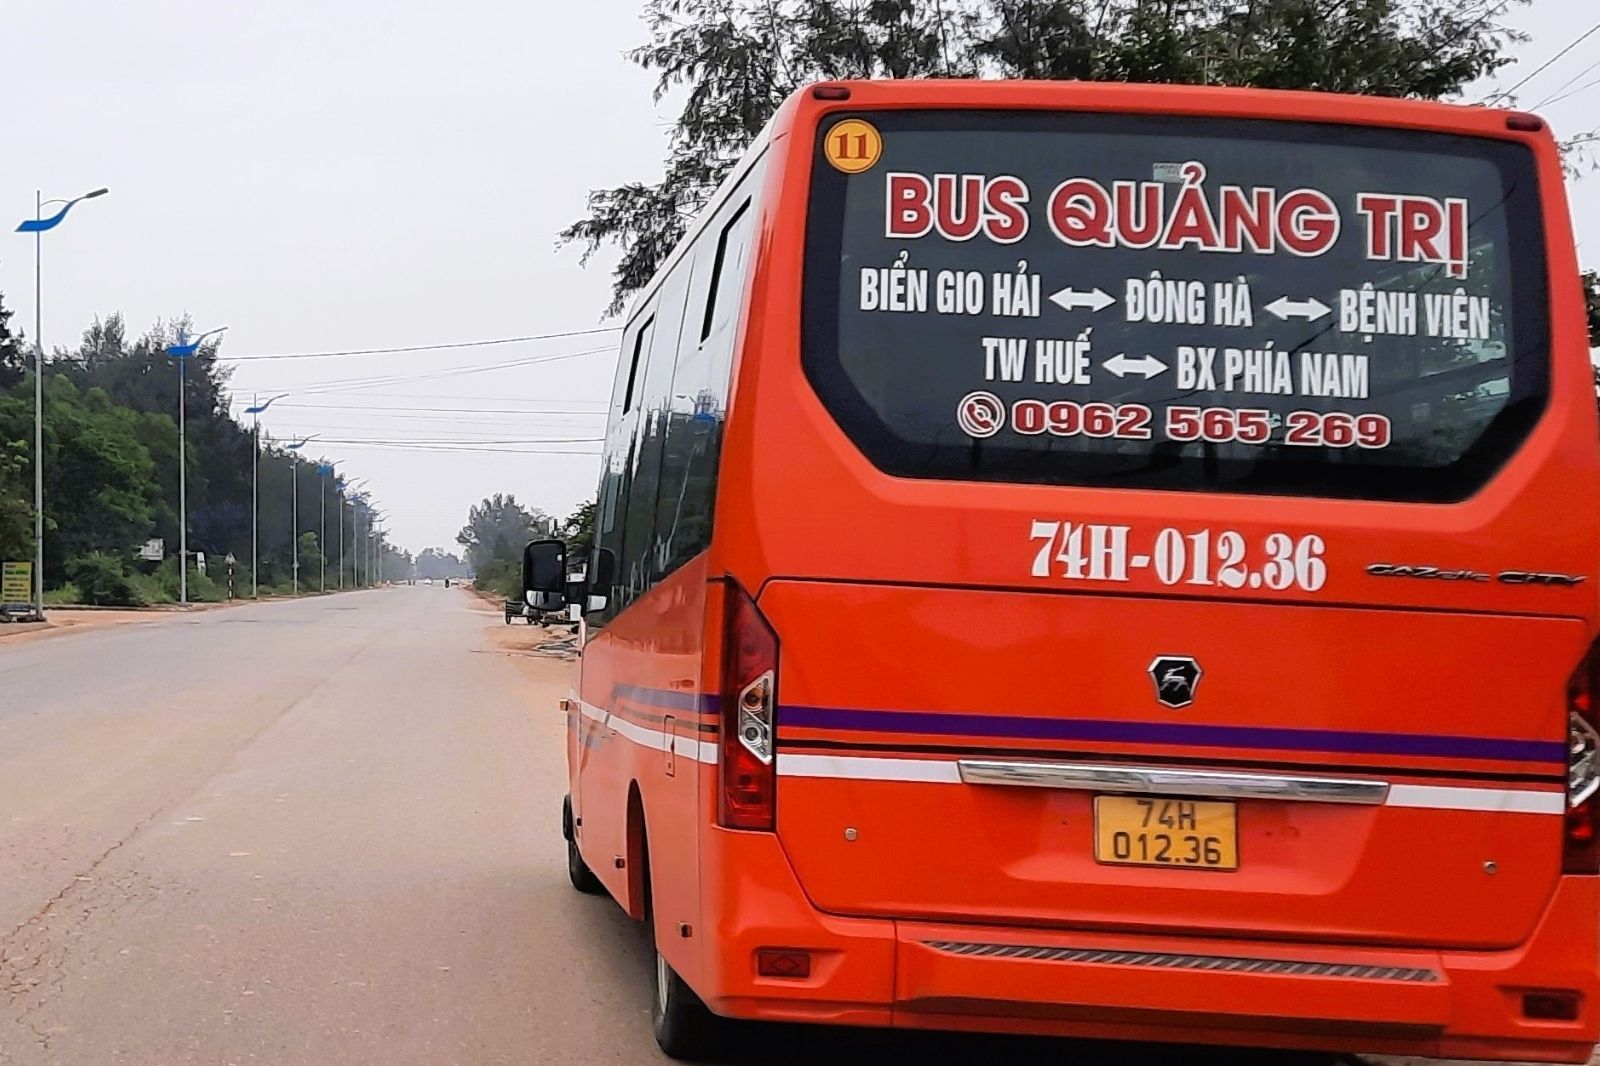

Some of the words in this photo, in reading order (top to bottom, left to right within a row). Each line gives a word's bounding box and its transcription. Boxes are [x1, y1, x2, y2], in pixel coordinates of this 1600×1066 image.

[835, 132, 870, 160] 11
[885, 173, 1030, 245] BUS
[1047, 161, 1341, 257] QUẢNG
[1356, 192, 1469, 280] TRỊ
[860, 250, 928, 312] BIỂN
[936, 269, 985, 315] GIO
[992, 259, 1041, 317] HẢI
[1125, 270, 1206, 325] ĐÔNG
[1214, 275, 1254, 327] HÀ
[1340, 281, 1417, 343] BỆNH
[1424, 287, 1490, 344] VIỆN
[981, 336, 1028, 382] TW
[1035, 326, 1094, 385] HUẾ
[1176, 346, 1217, 391] BX
[1224, 340, 1294, 395] PHÍA
[1301, 352, 1369, 399] NAM
[1011, 399, 1152, 440] 0962
[1166, 405, 1271, 444] 565
[1285, 412, 1392, 449] 269
[1029, 518, 1328, 592] 74H-012.36
[1136, 799, 1196, 831] 74H
[1112, 831, 1222, 866] 012.36
